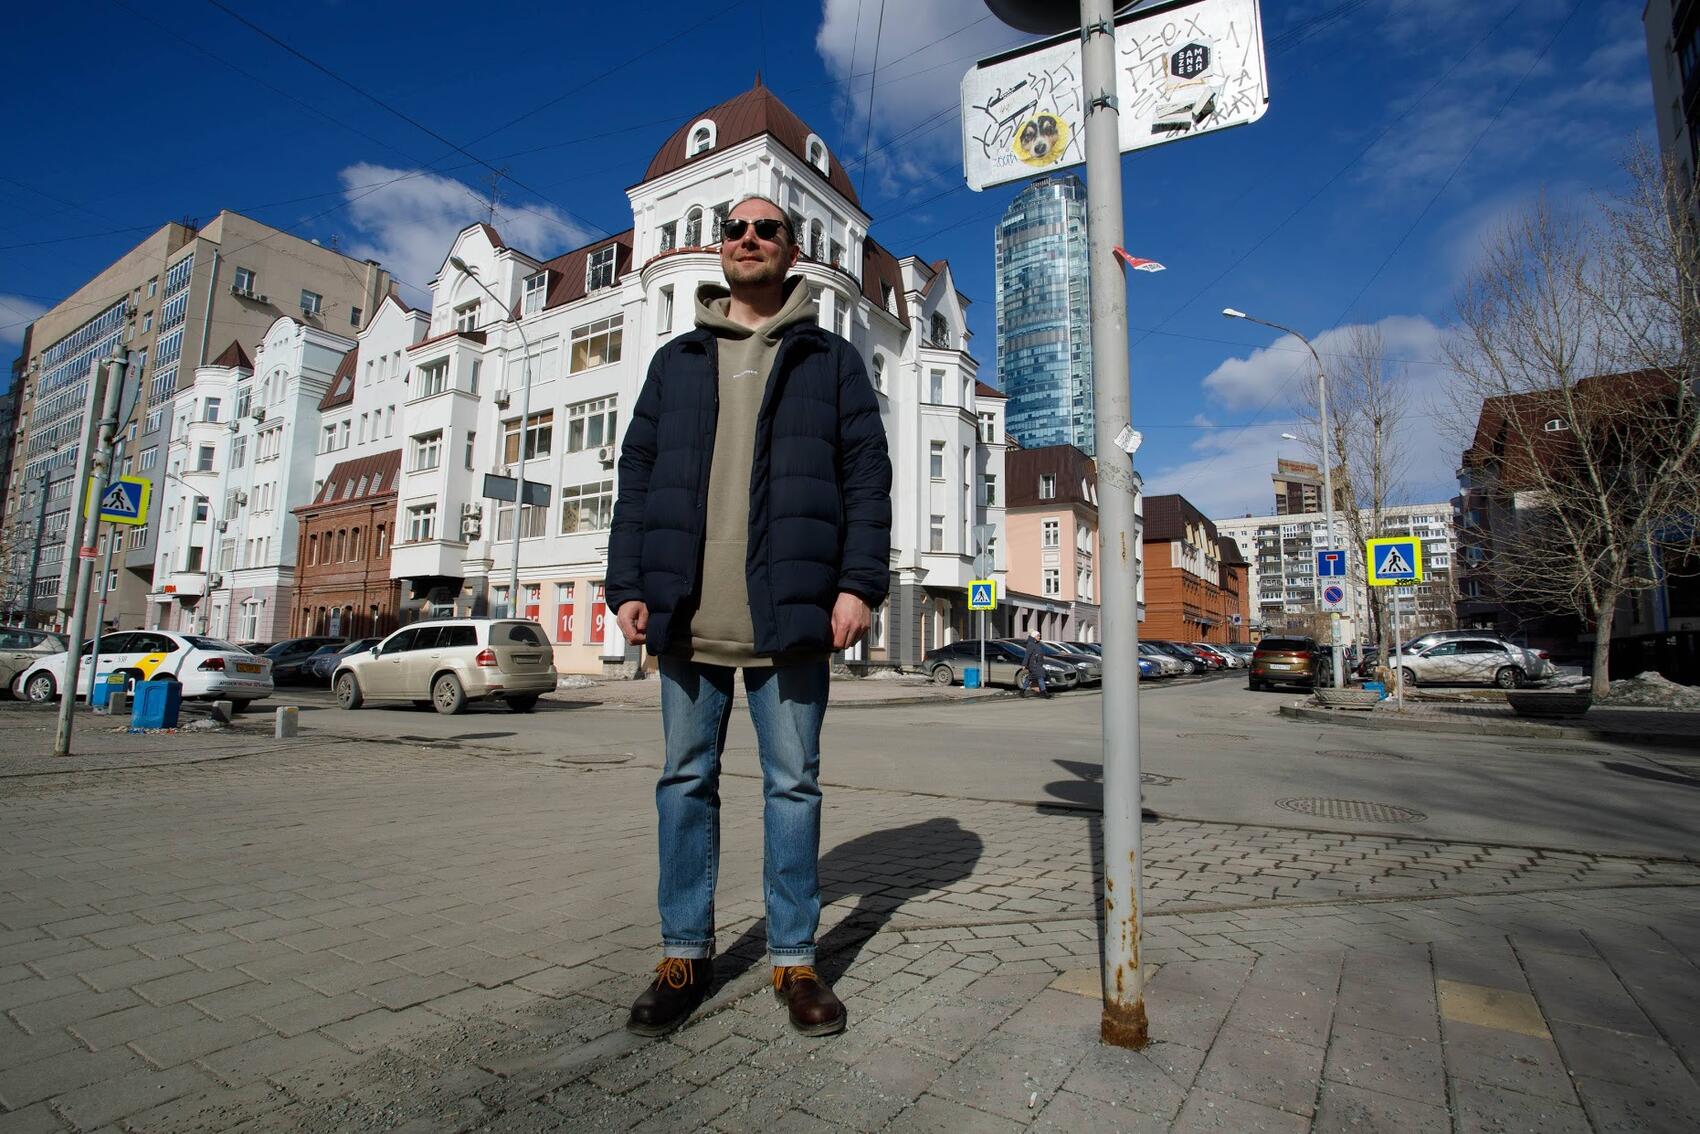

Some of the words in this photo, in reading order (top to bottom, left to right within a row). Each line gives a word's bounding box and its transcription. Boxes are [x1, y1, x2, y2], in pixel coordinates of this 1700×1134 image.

[1178, 47, 1203, 59] SAM
[1178, 55, 1203, 67] ZNA
[1178, 63, 1203, 75] ESH
